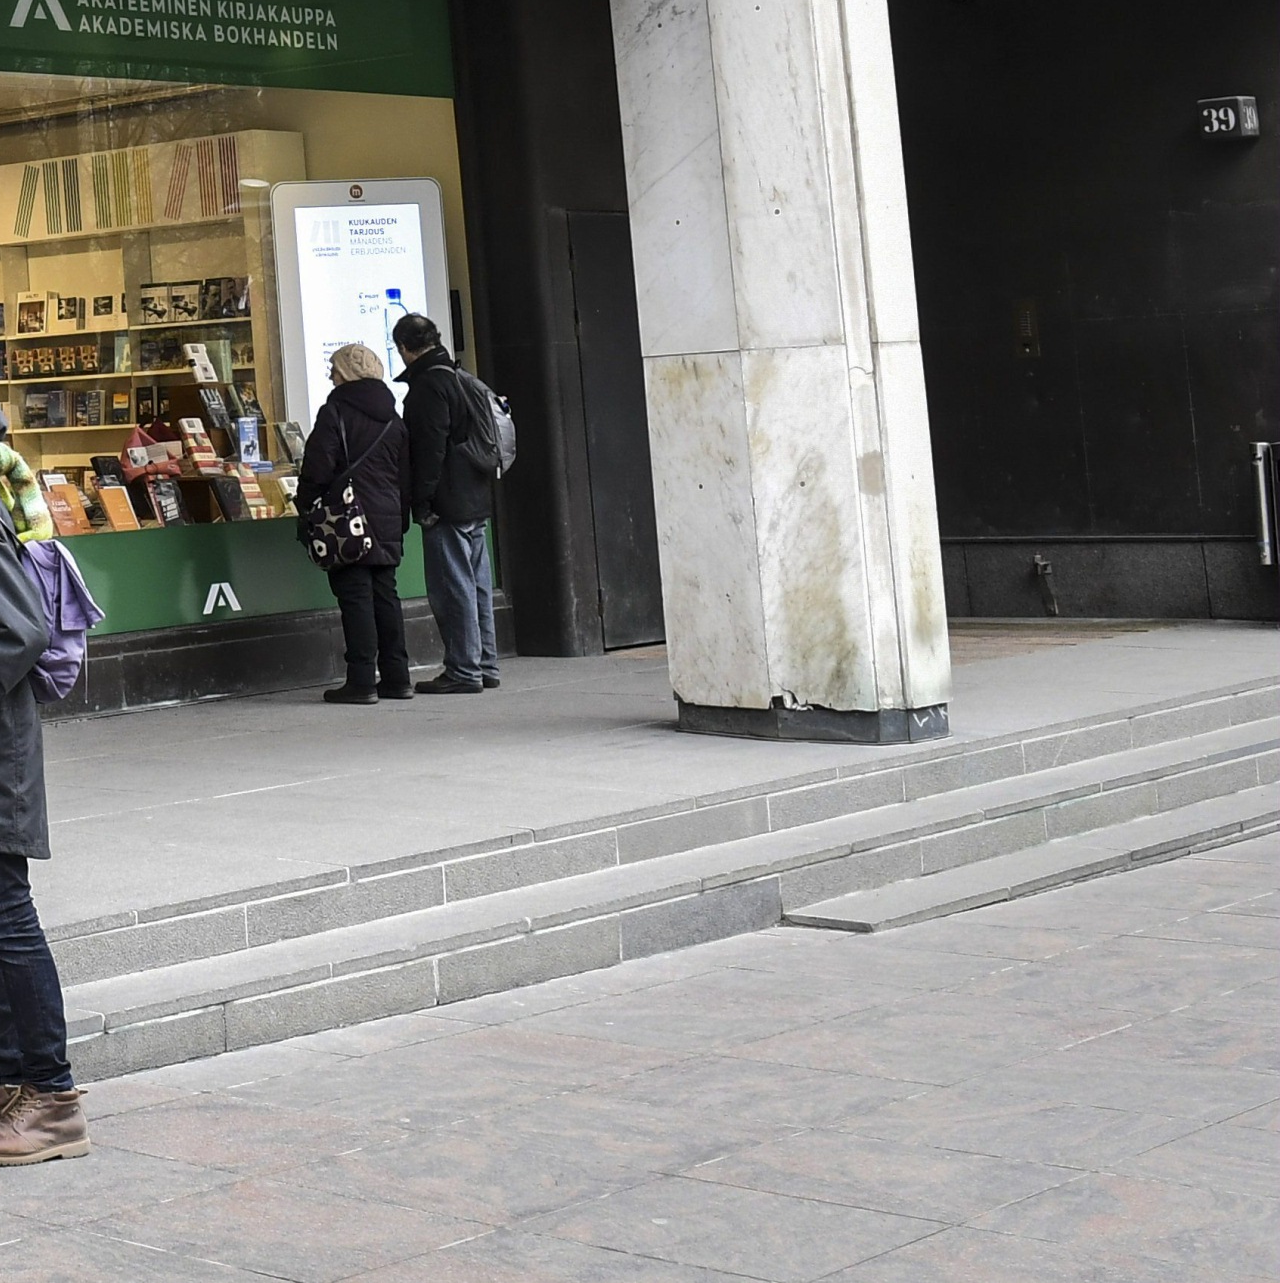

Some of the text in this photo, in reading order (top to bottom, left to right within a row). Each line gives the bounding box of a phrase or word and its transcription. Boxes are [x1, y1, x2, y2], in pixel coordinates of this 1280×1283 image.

[217, 0, 336, 28] KIRJAKAUPPA
[78, 14, 339, 52] AKADEMISKA BOKHANDELN
[1202, 107, 1236, 133] 39
[348, 218, 397, 226] KUUKAUDEN
[349, 228, 385, 236] TARJOUS
